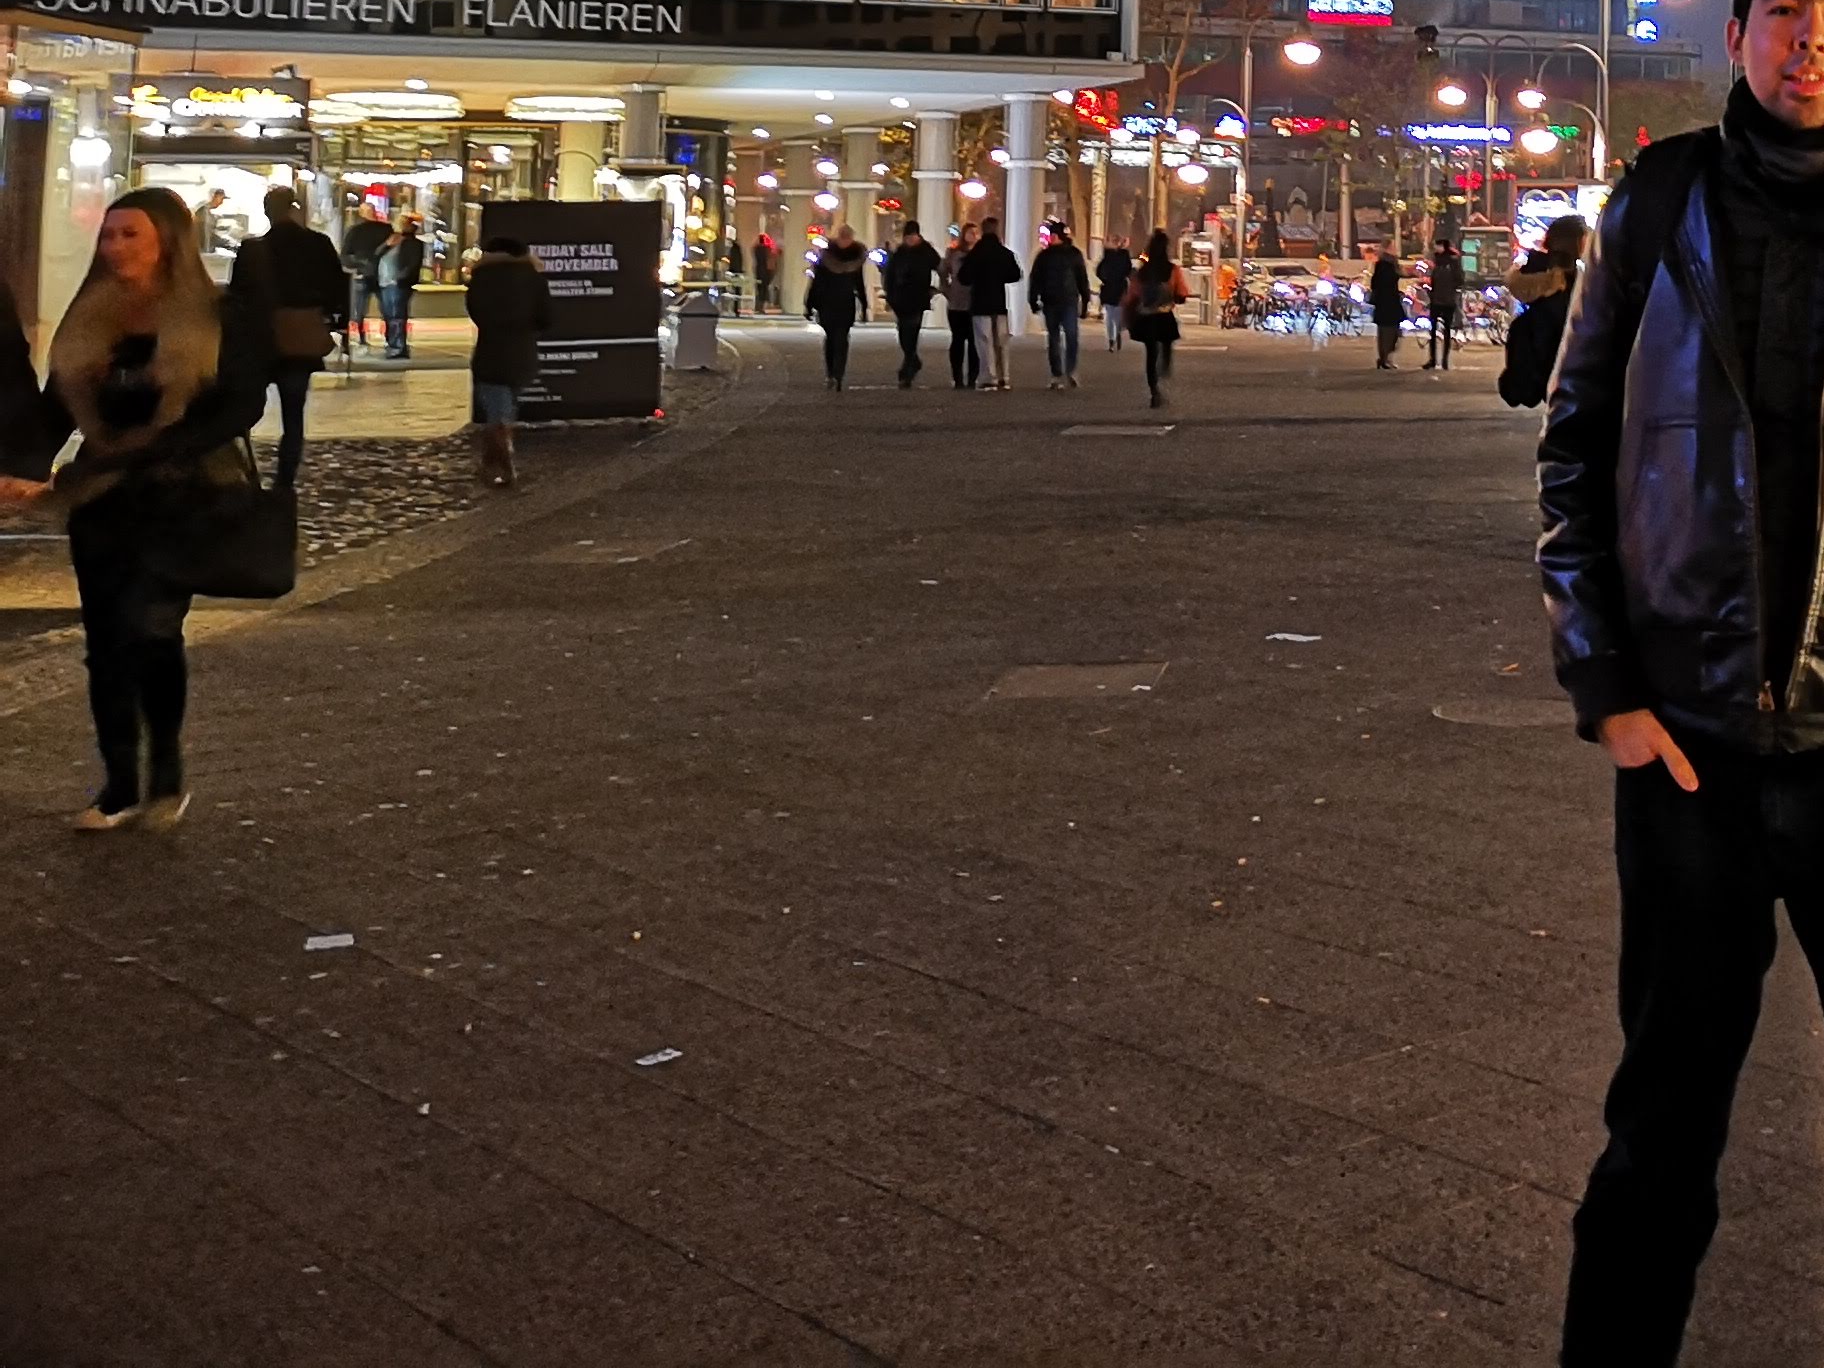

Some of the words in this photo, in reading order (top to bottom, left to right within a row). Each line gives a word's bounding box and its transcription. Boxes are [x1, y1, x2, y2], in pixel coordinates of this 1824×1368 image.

[529, 244, 577, 257] FRIDAY
[580, 244, 613, 257] SALE
[545, 259, 618, 271] NOVEMBER
